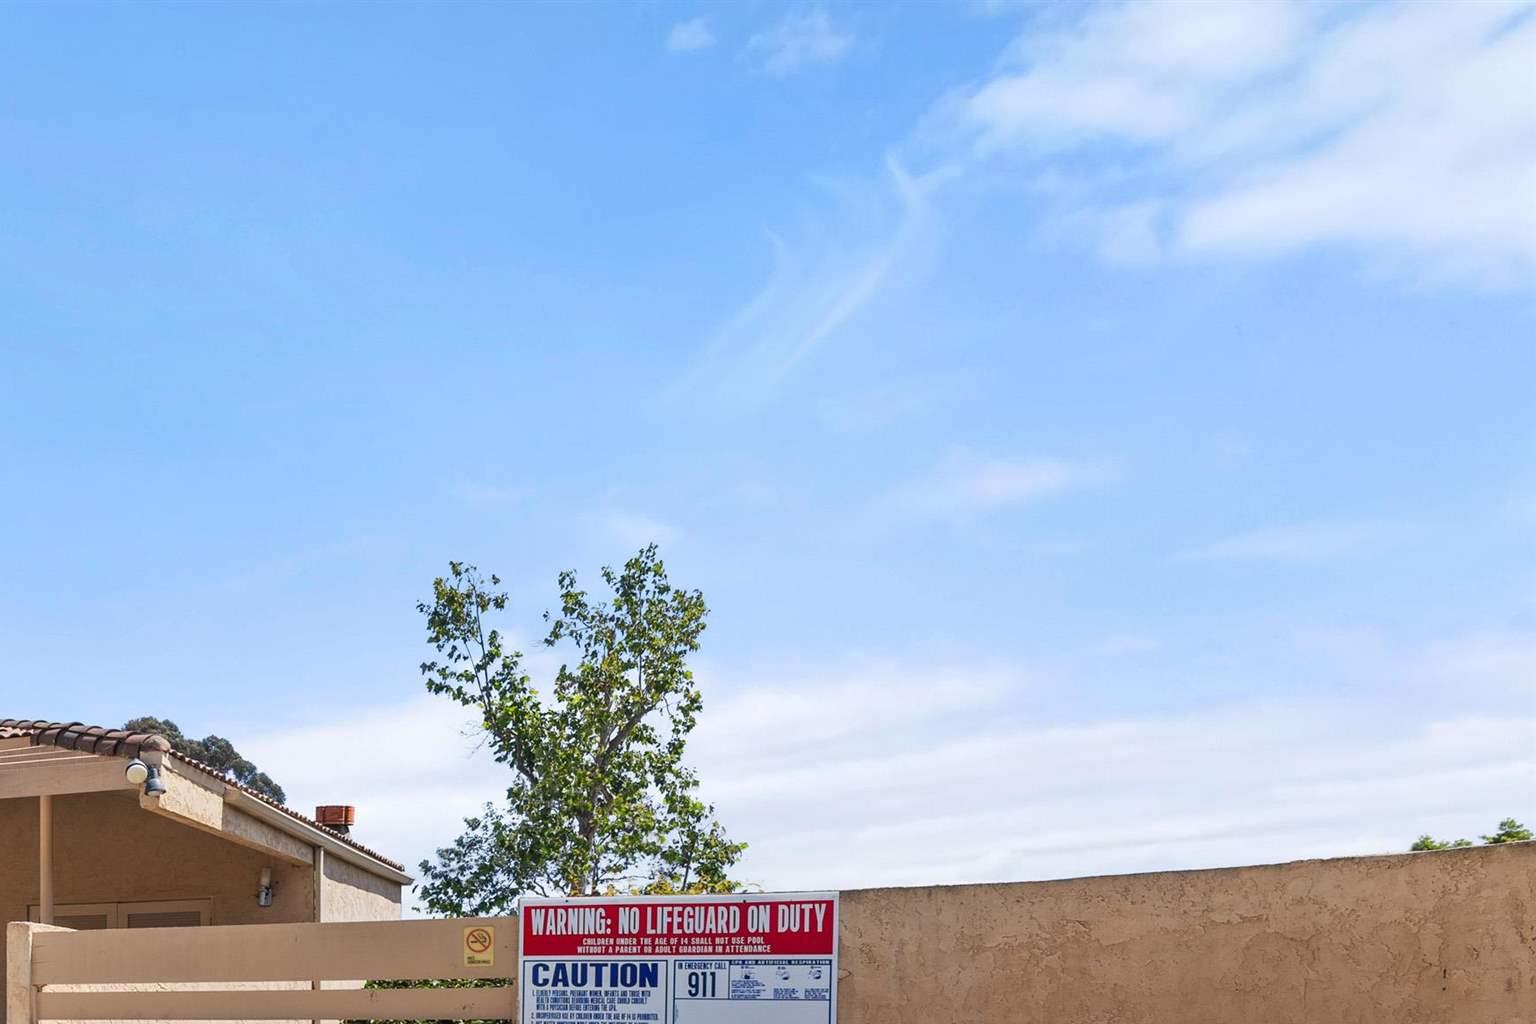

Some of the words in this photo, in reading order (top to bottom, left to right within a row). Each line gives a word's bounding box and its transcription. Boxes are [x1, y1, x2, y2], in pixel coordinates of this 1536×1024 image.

[531, 907, 612, 935] WARNING:
[618, 906, 640, 935] NO
[646, 905, 740, 934] LIFEGUARD
[747, 904, 771, 934] ON
[777, 903, 827, 933] DUTY
[577, 946, 606, 954] WITHOUT
[655, 945, 676, 953] ADULT
[679, 945, 713, 953] GUARDIAN
[715, 945, 723, 953] IN
[725, 944, 772, 953] ATTENDANCE
[640, 937, 652, 945] THE
[655, 937, 668, 945] AGE
[670, 937, 678, 945] OF
[681, 937, 689, 945] 14
[691, 937, 712, 945] SHALL
[747, 936, 765, 944] POOL
[531, 962, 659, 988] CAUTION
[688, 971, 716, 997] 911
